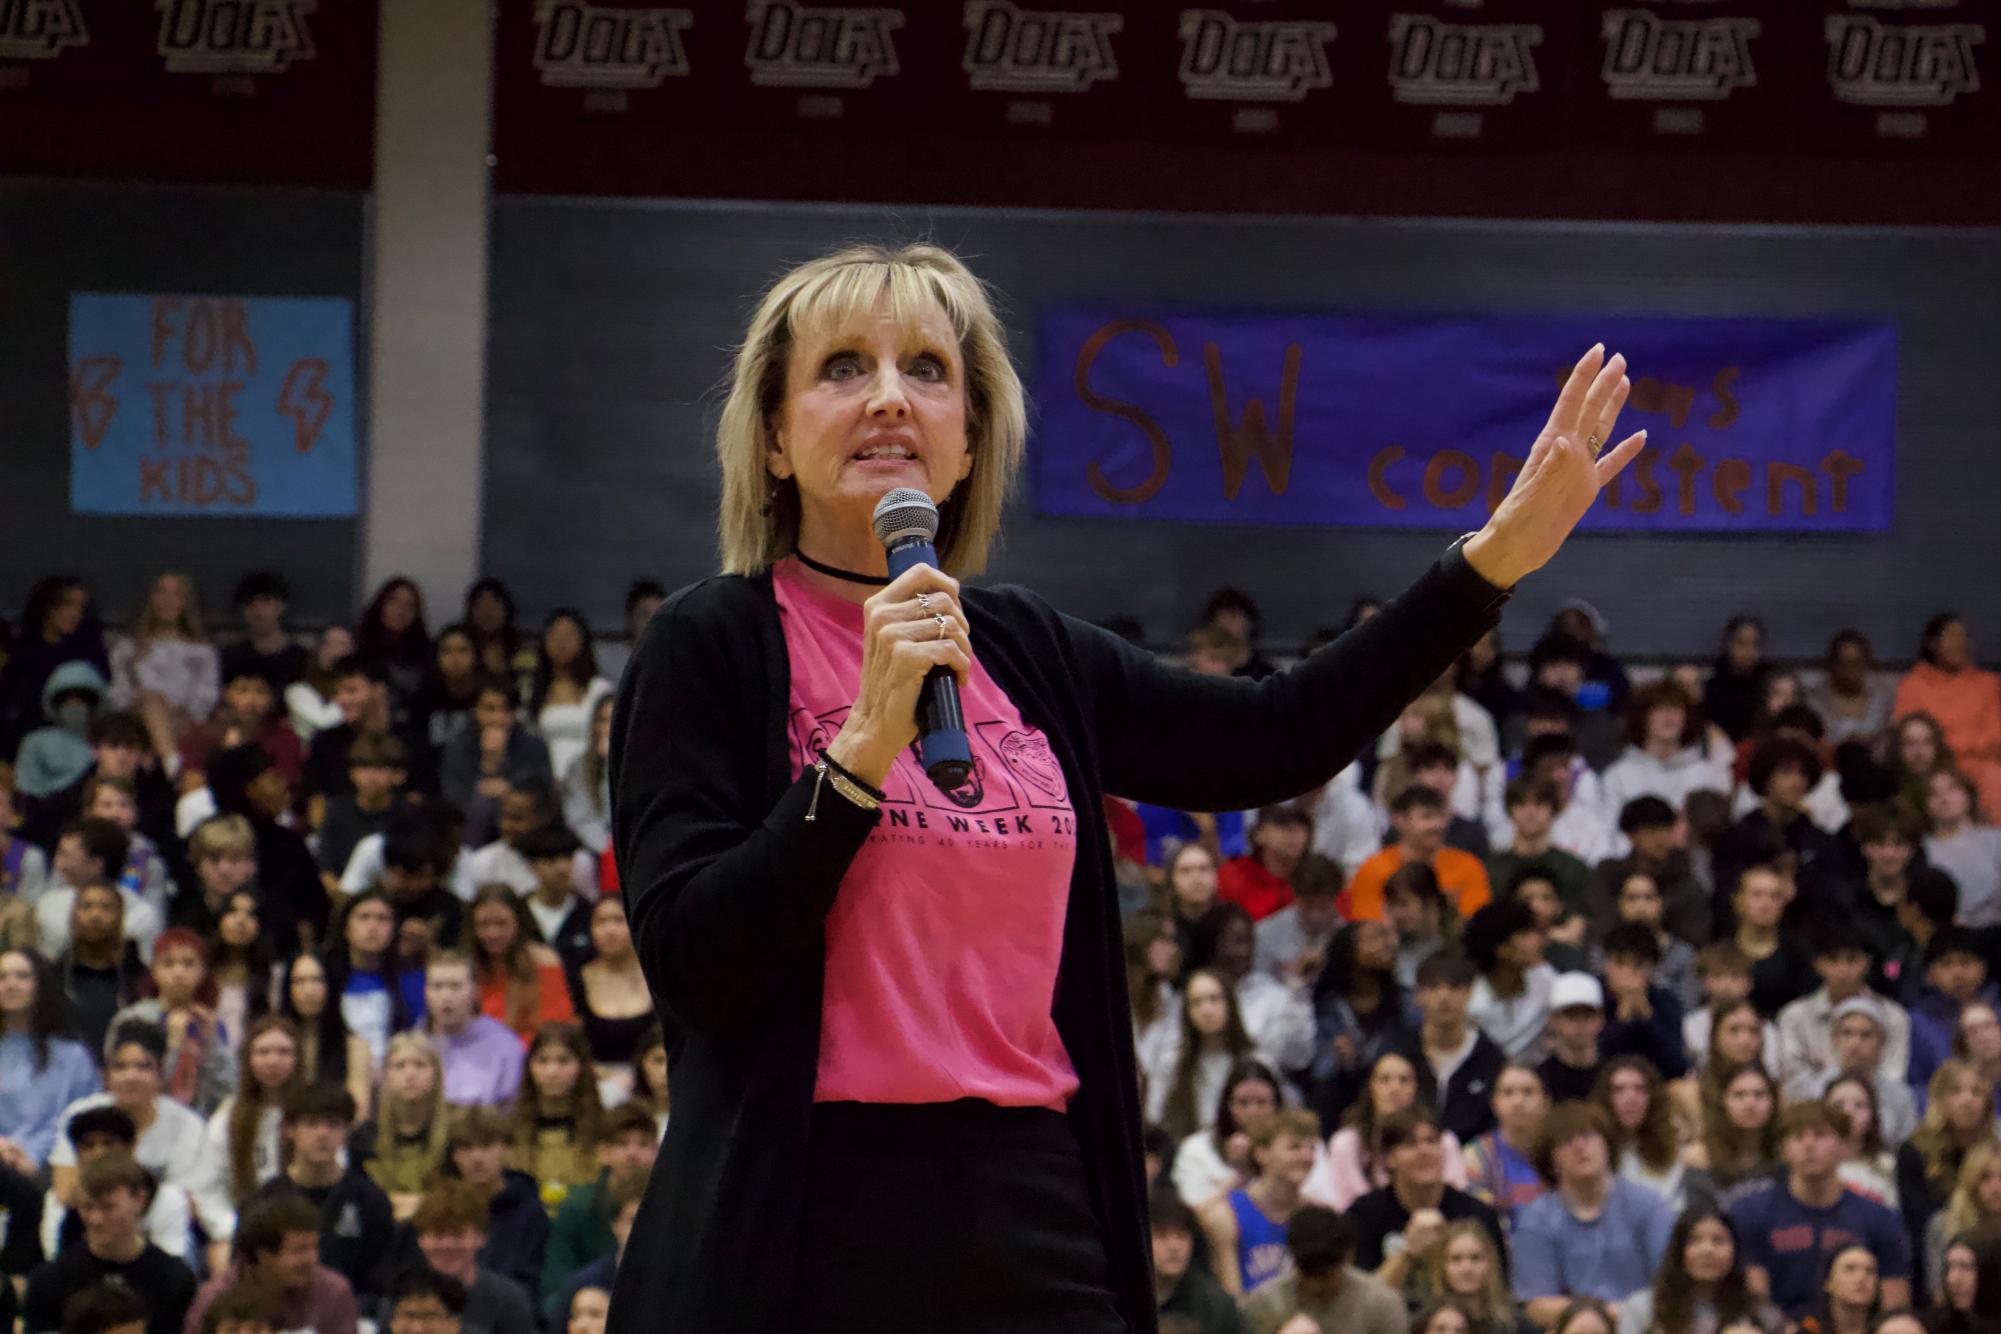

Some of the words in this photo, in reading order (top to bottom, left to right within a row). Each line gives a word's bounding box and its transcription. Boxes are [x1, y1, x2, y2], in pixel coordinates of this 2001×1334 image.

[151, 297, 257, 375] FOR
[147, 381, 246, 450] THE
[140, 449, 258, 506] KIDS
[869, 834, 926, 845] RATING
[967, 840, 1009, 849] YEARS
[945, 814, 1033, 835] WEEK
